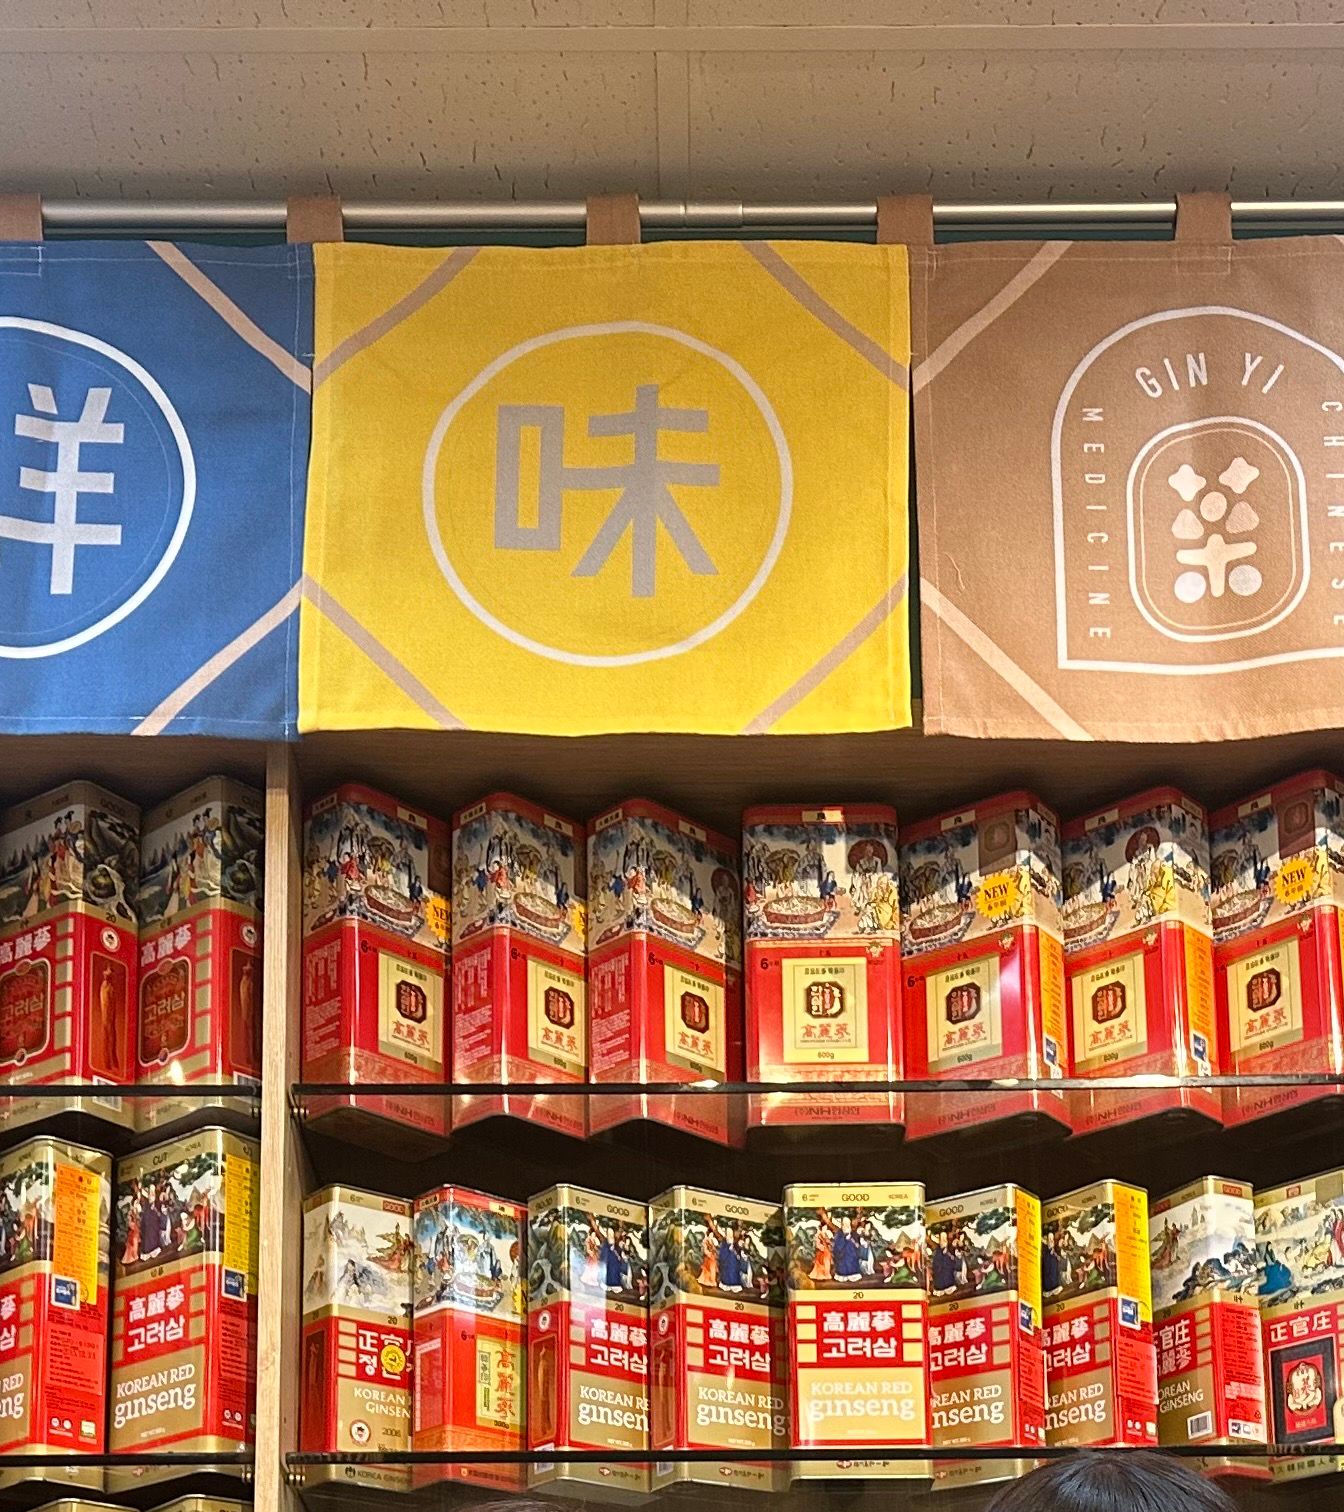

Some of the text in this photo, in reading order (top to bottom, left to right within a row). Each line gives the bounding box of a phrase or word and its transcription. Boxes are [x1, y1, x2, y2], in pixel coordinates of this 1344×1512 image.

[1135, 352, 1284, 399] GIN YI
[494, 384, 719, 597] 味
[1081, 407, 1111, 639] MEDICINE
[1282, 868, 1307, 887] NEW
[983, 883, 1010, 902] NEW
[153, 1151, 170, 1165] CUT
[841, 1193, 871, 1202] GOOD
[939, 1203, 965, 1217] GOOD
[129, 1283, 184, 1320] 高麗蔘
[852, 1291, 864, 1300] 20
[590, 1318, 647, 1347] 高麗蔘
[708, 1318, 770, 1346] 高麗蔘
[822, 1310, 894, 1333] 高麗蔘
[1270, 1310, 1332, 1343] 正官庄
[127, 1318, 184, 1352] 고려삼
[822, 1337, 897, 1359] 고려삼
[589, 1344, 647, 1374] 고려삼
[708, 1344, 770, 1371] 고려삼
[116, 1363, 195, 1399] KOREAN RED
[811, 1381, 913, 1396] KOREAN RED
[973, 1381, 1002, 1403] RED
[1077, 1381, 1104, 1404] RED
[113, 1382, 196, 1428] ginseng
[354, 1387, 406, 1405] KOREAN
[579, 1385, 633, 1409] KOREAN
[697, 1387, 783, 1412] KOREAN RED
[1159, 1388, 1204, 1414] GINSENG
[696, 1403, 790, 1436] ginseng
[806, 1395, 916, 1424] ginseng
